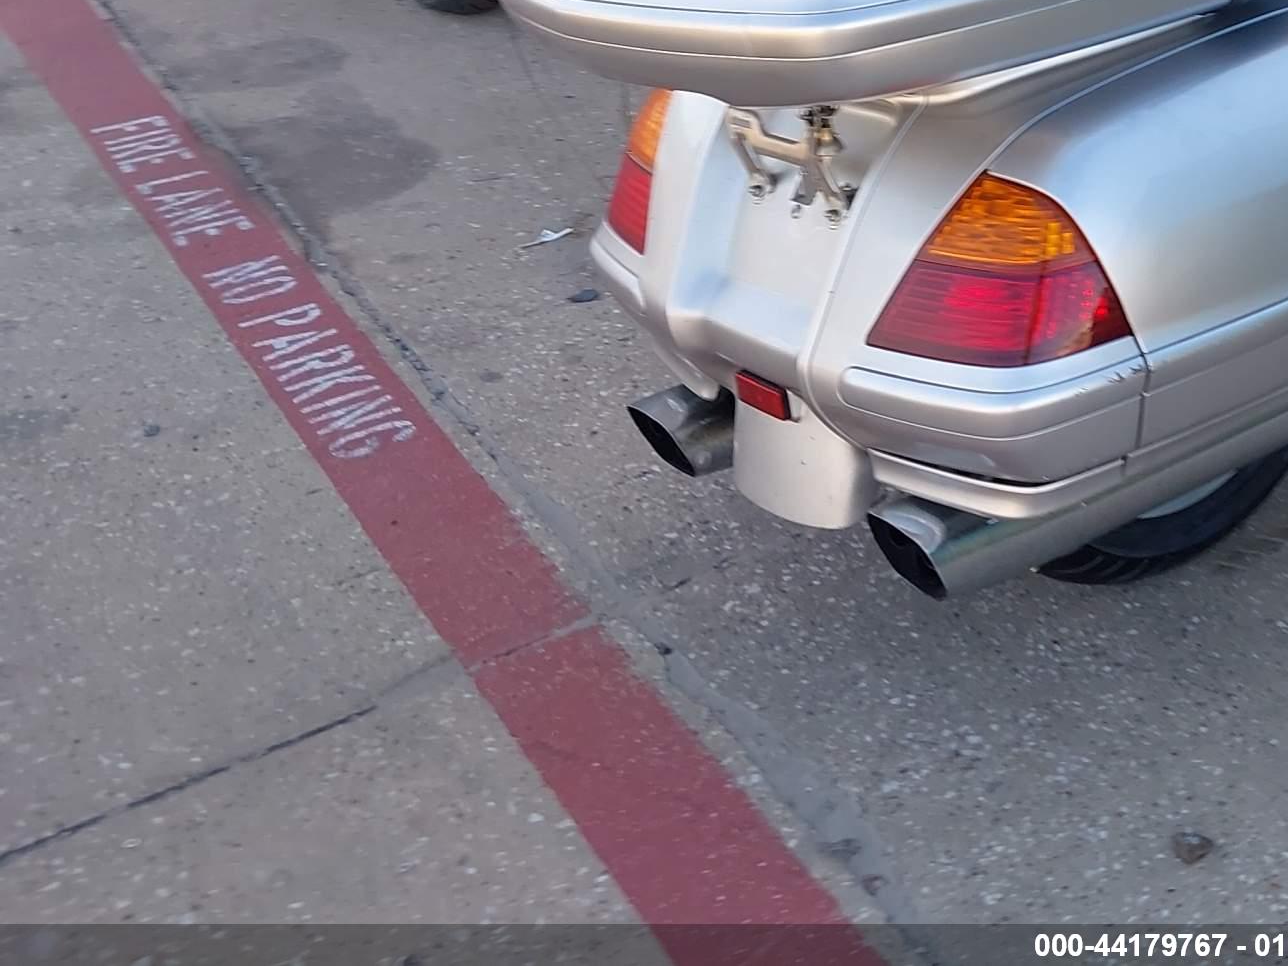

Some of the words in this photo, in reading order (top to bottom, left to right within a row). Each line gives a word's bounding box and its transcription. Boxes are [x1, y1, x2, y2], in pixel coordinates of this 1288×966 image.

[90, 115, 198, 174] FIRE
[135, 170, 255, 247] LANE
[202, 255, 299, 305] NO
[238, 303, 417, 459] PARKING
